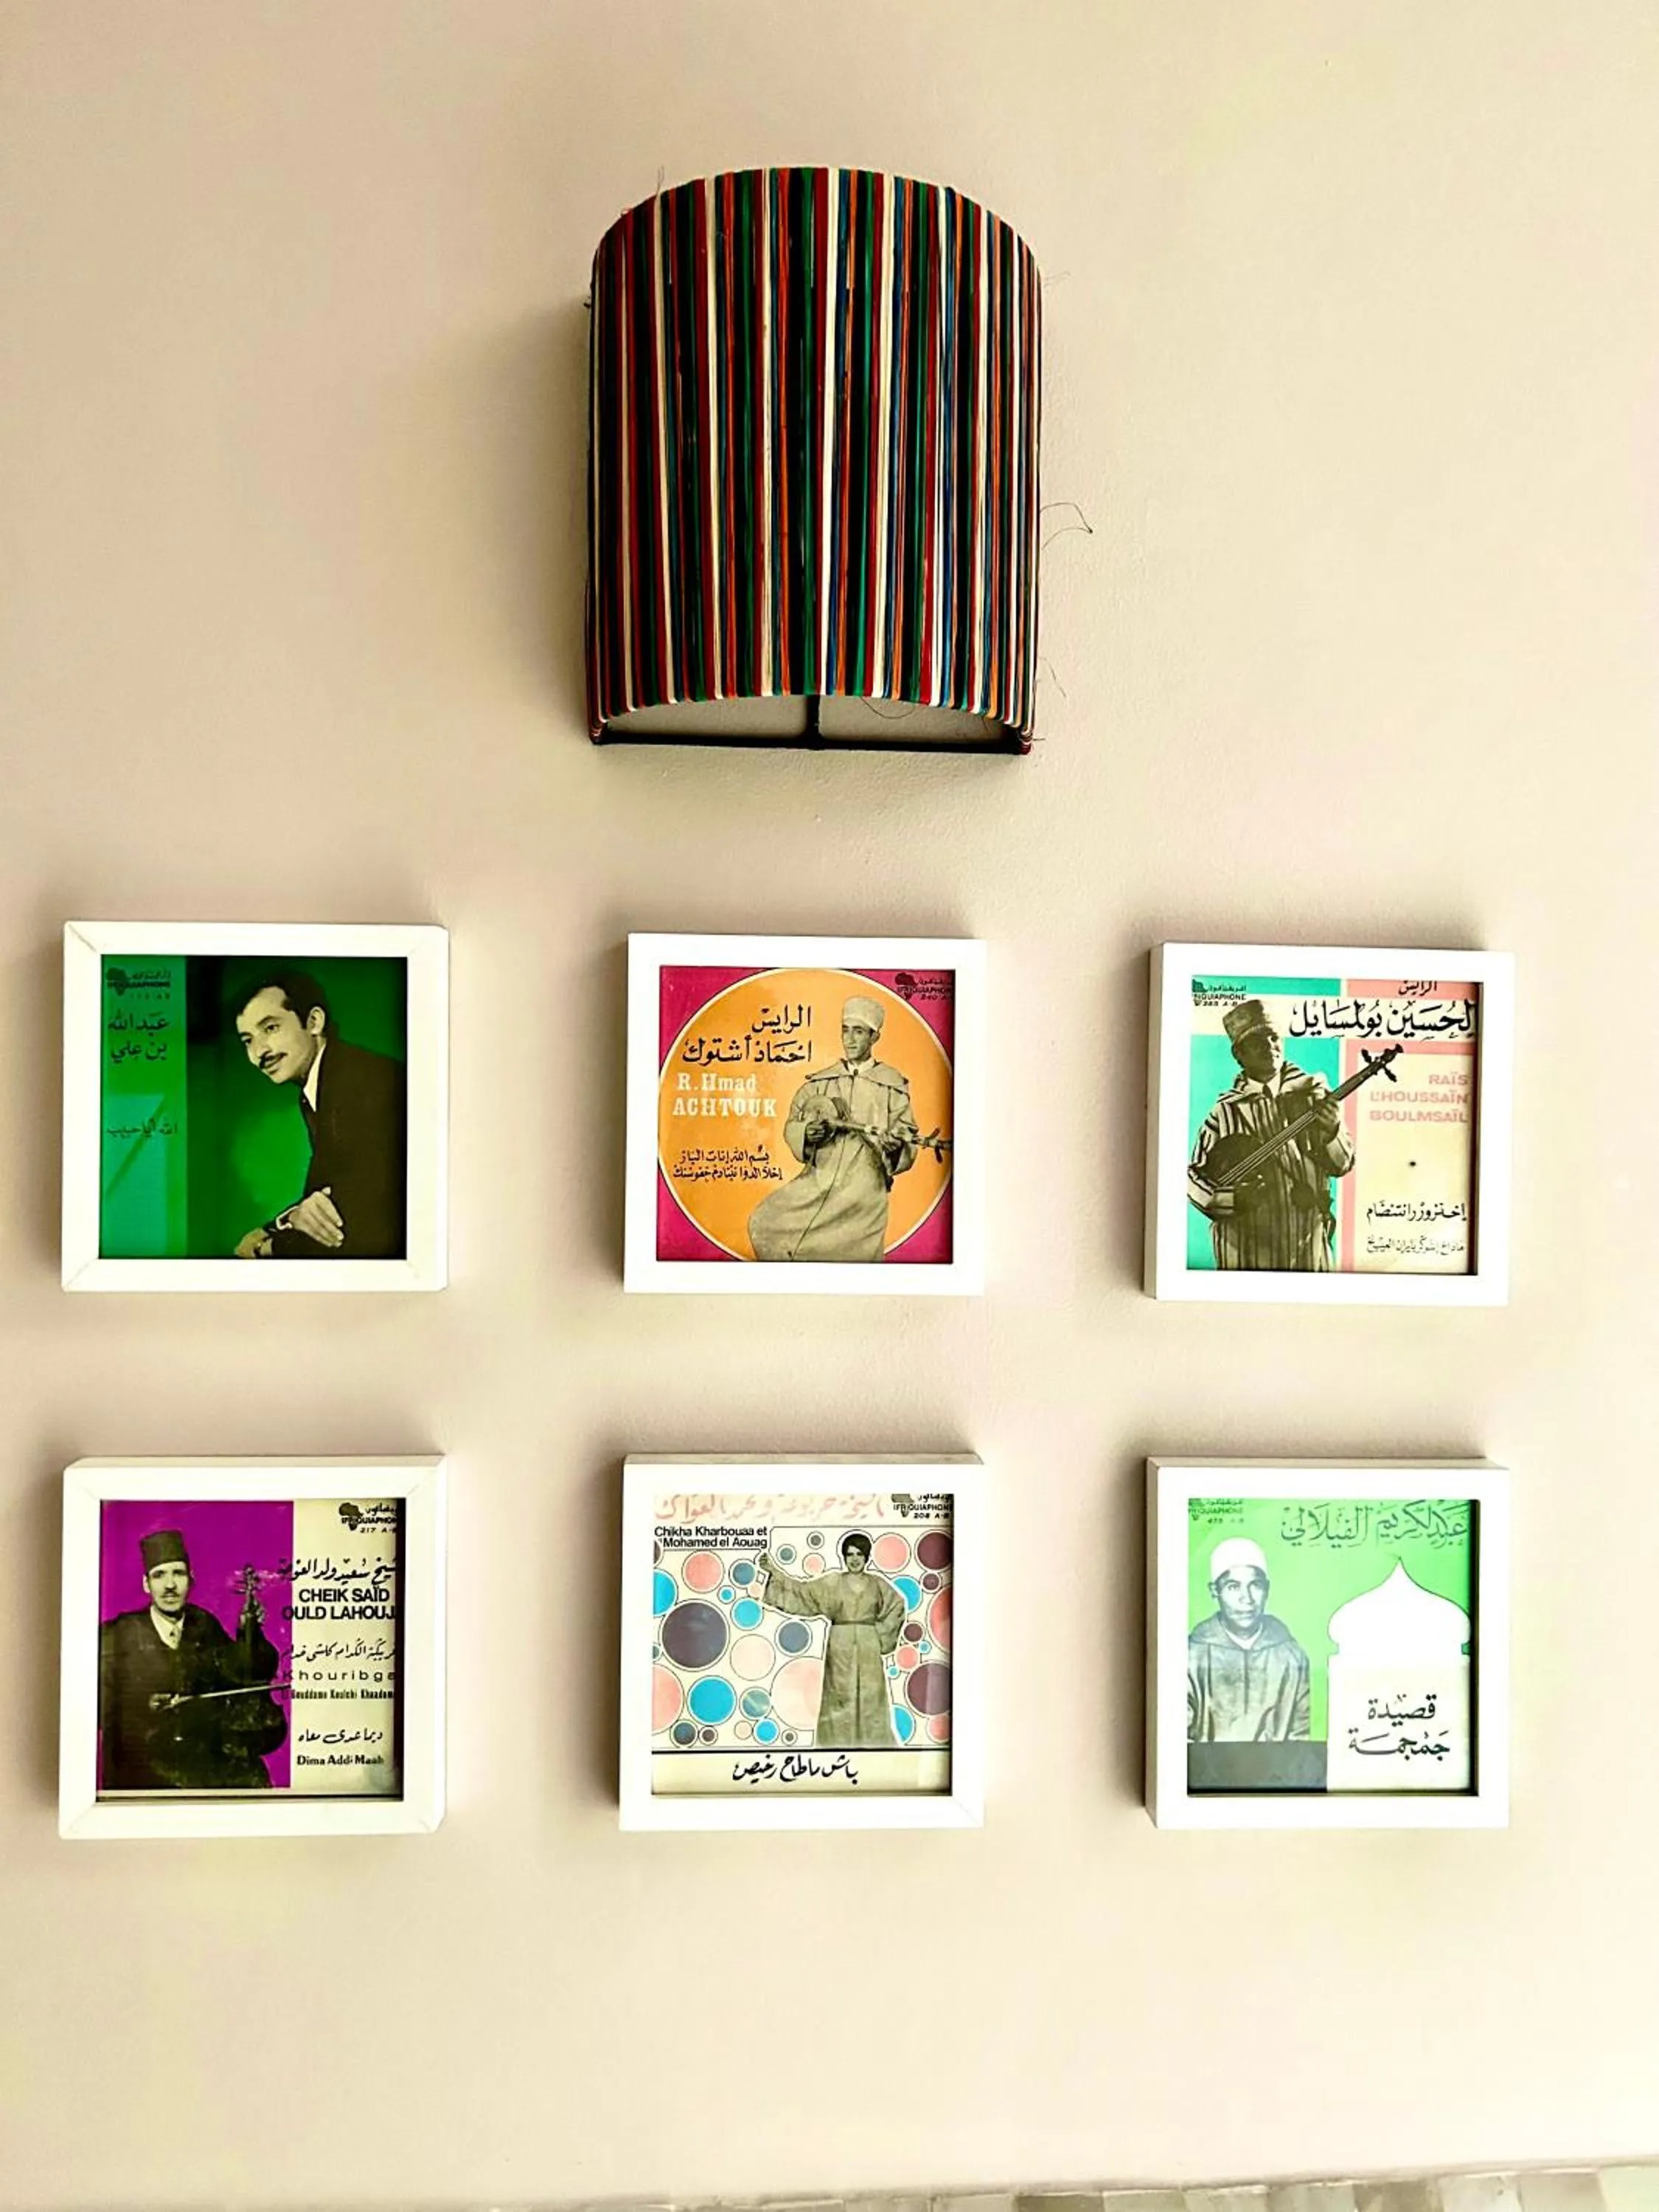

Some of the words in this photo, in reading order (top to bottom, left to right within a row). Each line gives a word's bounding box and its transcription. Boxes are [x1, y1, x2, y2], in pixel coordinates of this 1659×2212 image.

[672, 1096, 778, 1118] ACHTOUK
[654, 1526, 692, 1537] Chikha
[756, 1526, 768, 1536] et
[664, 1537, 717, 1547] Mohamed
[719, 1537, 729, 1547] el
[732, 1537, 768, 1549] Aouag
[298, 1588, 349, 1602] CHEIK
[351, 1585, 390, 1602] SAÏD
[282, 1605, 327, 1620] OULD
[330, 1605, 397, 1620] LAHOUJ
[296, 1755, 326, 1765] Dima
[327, 1755, 353, 1765] Addi
